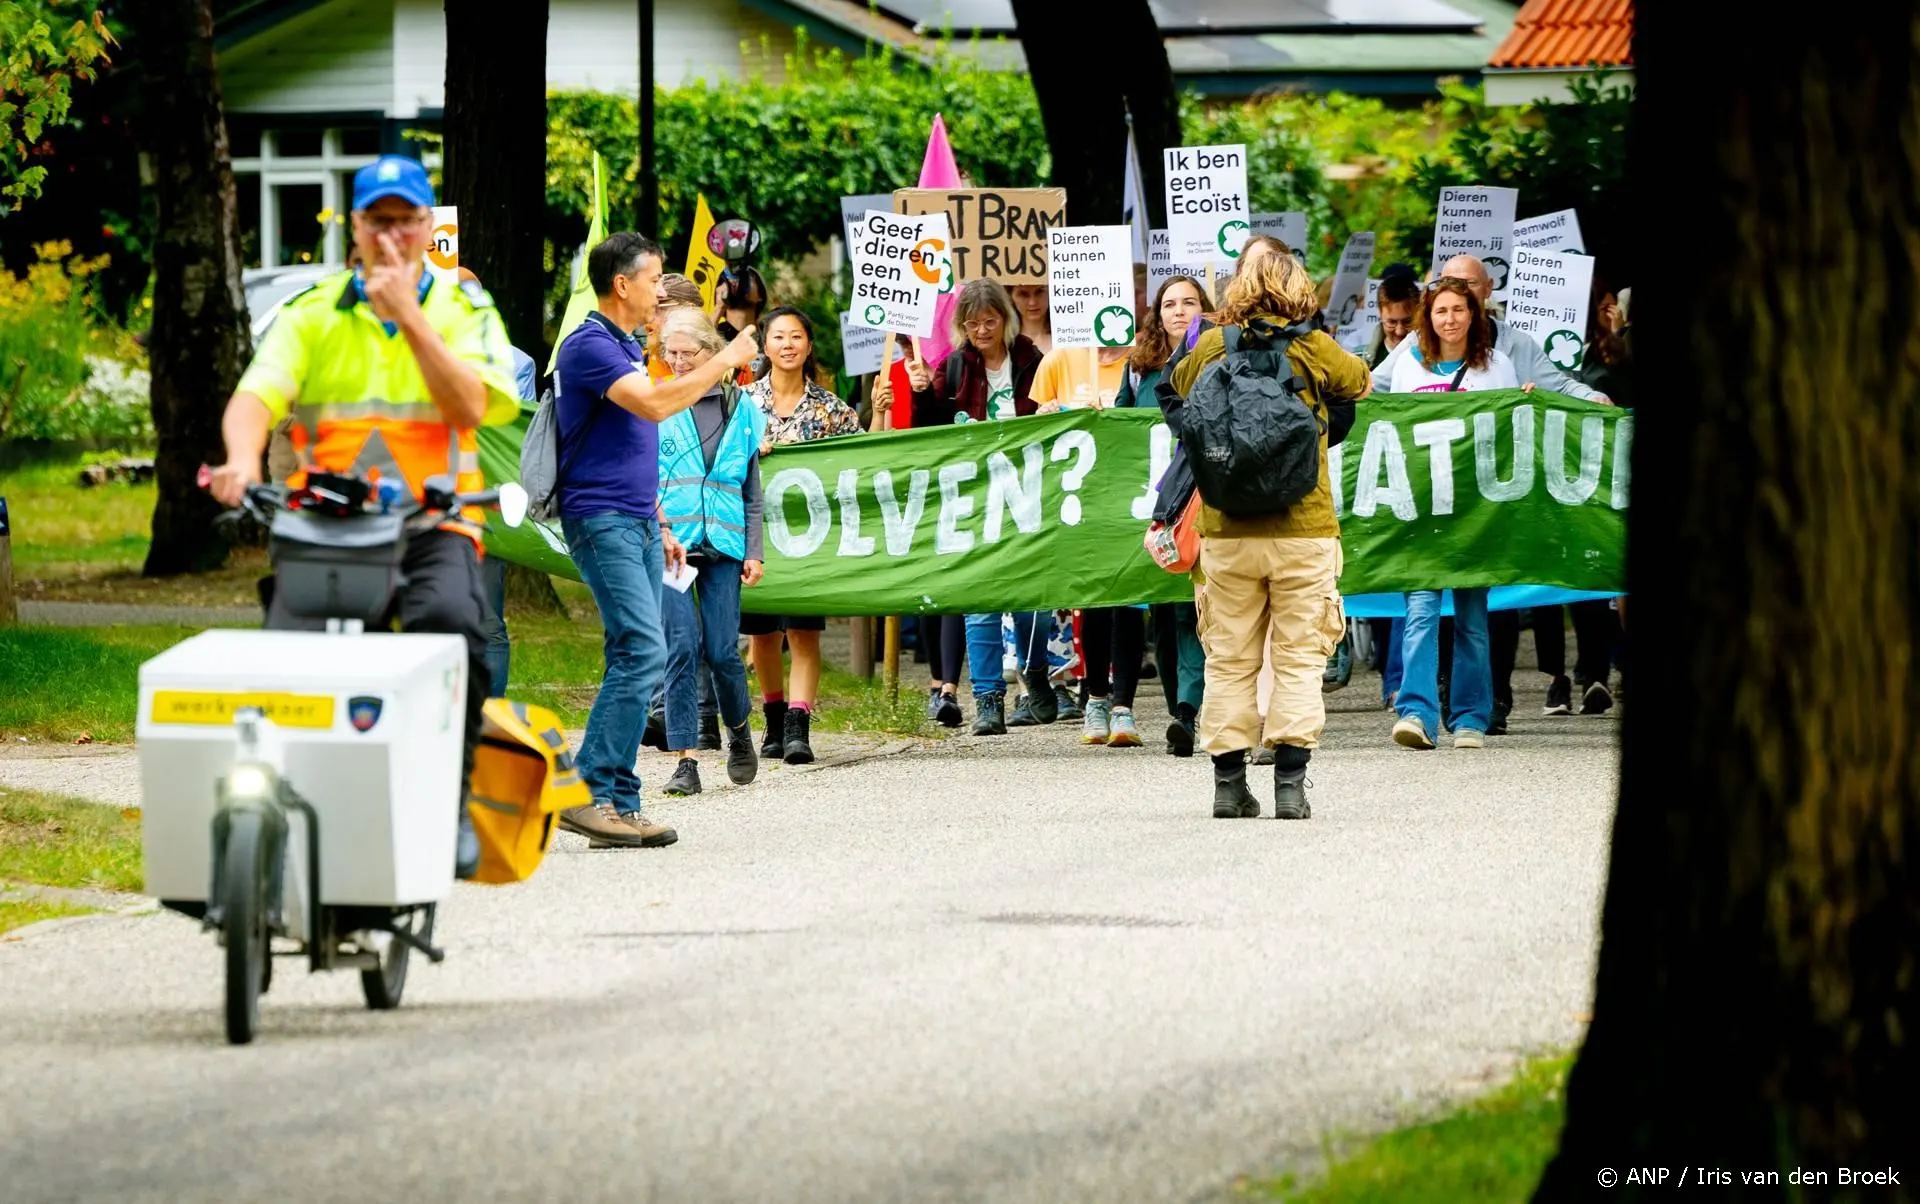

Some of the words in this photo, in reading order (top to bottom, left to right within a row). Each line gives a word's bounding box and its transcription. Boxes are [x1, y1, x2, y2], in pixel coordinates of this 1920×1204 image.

[1169, 150, 1189, 171] Ik
[1197, 149, 1240, 169] ben
[1170, 175, 1211, 192] een
[1172, 193, 1241, 215] Ecoïst
[1443, 191, 1488, 203] Dieren
[1442, 206, 1492, 217] kunnen
[868, 215, 924, 242] Geef
[1441, 221, 1467, 233] niet
[1052, 232, 1099, 245] Dieren
[1440, 236, 1487, 250] kiezen,
[1489, 236, 1503, 250] jij
[865, 237, 935, 265] dieren
[1053, 250, 1106, 262] kunnen
[982, 244, 1049, 277] RUS
[1517, 251, 1563, 269] Dieren
[861, 262, 901, 282] een
[1053, 266, 1080, 279] niet
[1514, 268, 1566, 286] kunnen
[857, 281, 921, 306] stem!
[1053, 284, 1104, 298] kiezen,
[1108, 282, 1121, 298] jij
[1512, 286, 1539, 299] niet
[1054, 301, 1084, 314] wel!
[1511, 301, 1560, 320] kiezen,
[1562, 308, 1576, 324] jij
[1509, 318, 1538, 332] wel!
[847, 336, 886, 350] veehou
[762, 431, 1097, 558] OLVEN?
